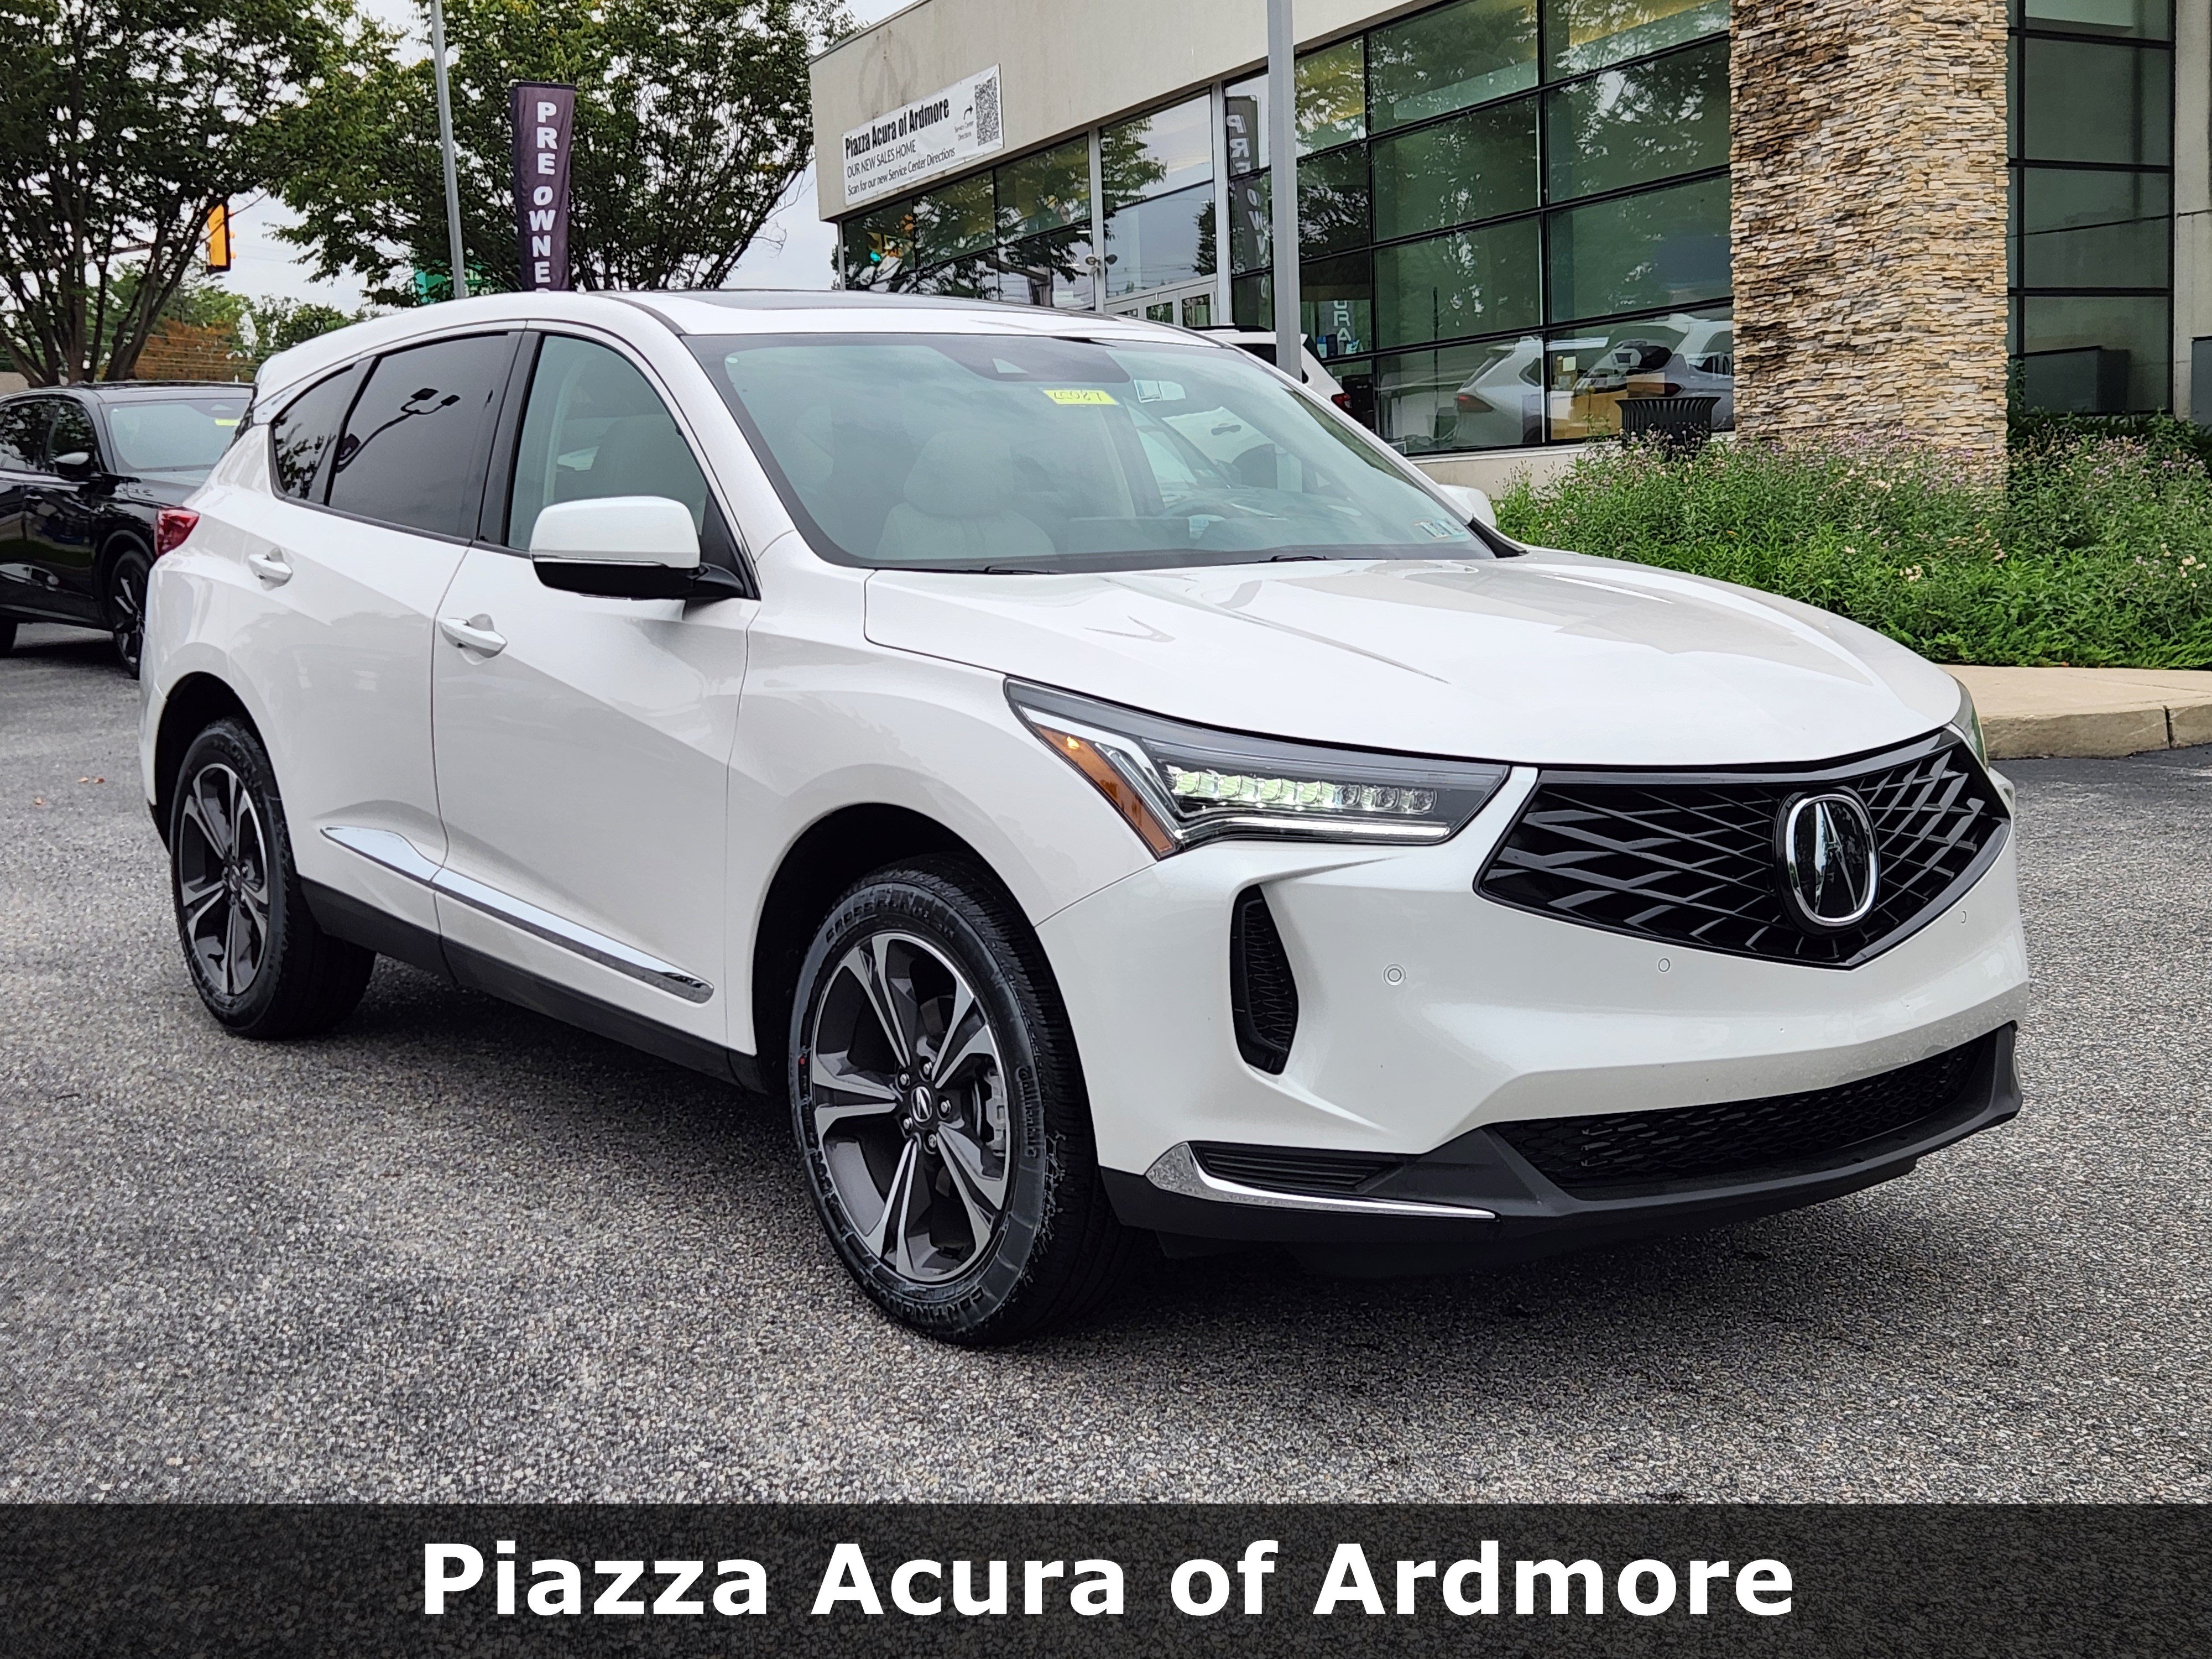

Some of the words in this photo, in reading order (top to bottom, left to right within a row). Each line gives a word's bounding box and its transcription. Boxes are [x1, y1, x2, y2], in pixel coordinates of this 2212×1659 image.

[536, 101, 558, 175] PRE
[845, 133, 870, 160] Piazza
[872, 121, 896, 149] Acura
[898, 112, 907, 137] of
[909, 98, 950, 133] Ardmore
[847, 163, 860, 179] OUR
[861, 155, 876, 173] NEW
[877, 148, 895, 167] SALES
[895, 139, 916, 160] HOME
[848, 184, 859, 196] Scan
[868, 178, 876, 189] our
[877, 174, 888, 185] new
[889, 165, 907, 181] Service
[908, 159, 926, 173] Center
[926, 147, 955, 166] Directions
[529, 186, 556, 293] OWNE
